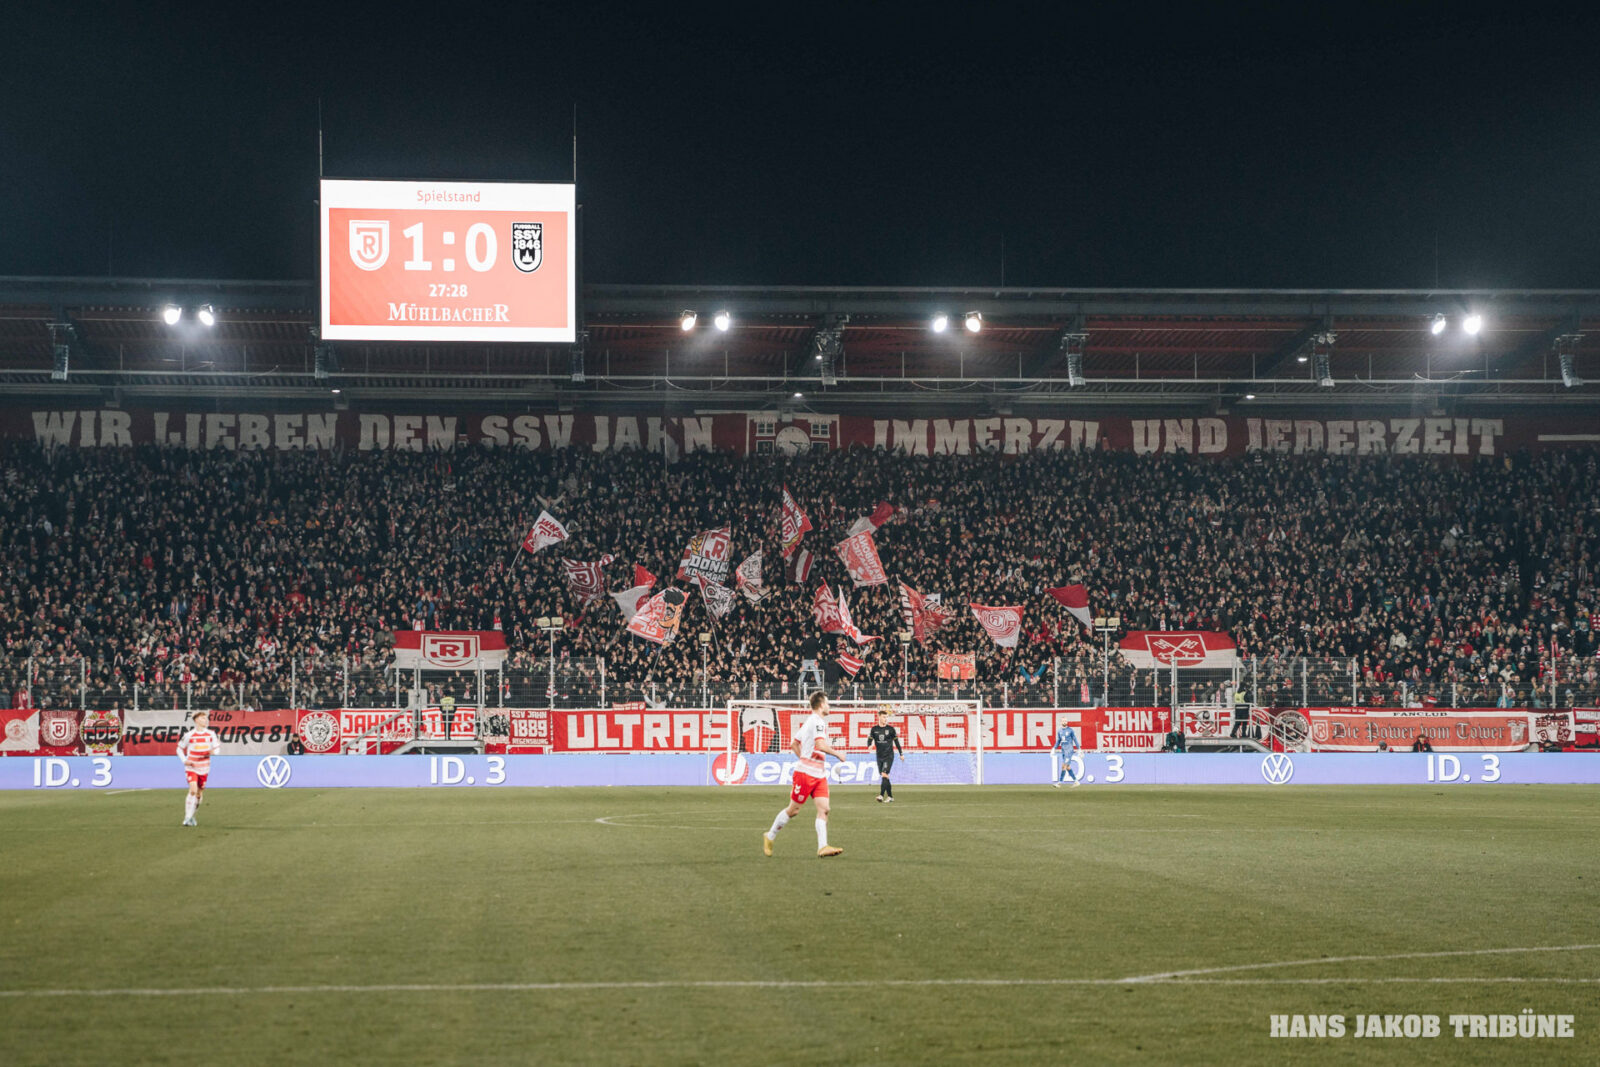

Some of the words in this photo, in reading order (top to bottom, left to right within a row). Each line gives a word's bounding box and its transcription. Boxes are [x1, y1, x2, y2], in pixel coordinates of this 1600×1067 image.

[416, 190, 481, 203] Spielstand
[513, 229, 541, 240] SSV
[513, 240, 541, 250] 1846
[402, 222, 498, 272] 1:0
[429, 284, 468, 298] 27:28
[32, 410, 134, 448] WIR
[153, 412, 338, 450] LIEBEN
[358, 413, 457, 452] DEN
[480, 414, 574, 451] SSV
[1131, 417, 1228, 454] UND
[1246, 416, 1504, 456] JEDERZEIT
[184, 711, 233, 723] Fclub
[1102, 711, 1154, 732] JAHN
[268, 725, 293, 742] 81
[511, 719, 548, 738] 1889
[566, 713, 728, 749] ULTRAS
[1330, 721, 1360, 740] Die
[1364, 721, 1416, 742] Power
[1455, 721, 1505, 740] Tower
[1102, 735, 1154, 748] STADION
[33, 758, 80, 787] ID.
[91, 757, 113, 787] 3
[430, 756, 475, 784] ID.
[486, 756, 506, 784] 3
[1105, 754, 1125, 783] 3
[1427, 754, 1471, 782] ID.
[1481, 753, 1501, 782] 3
